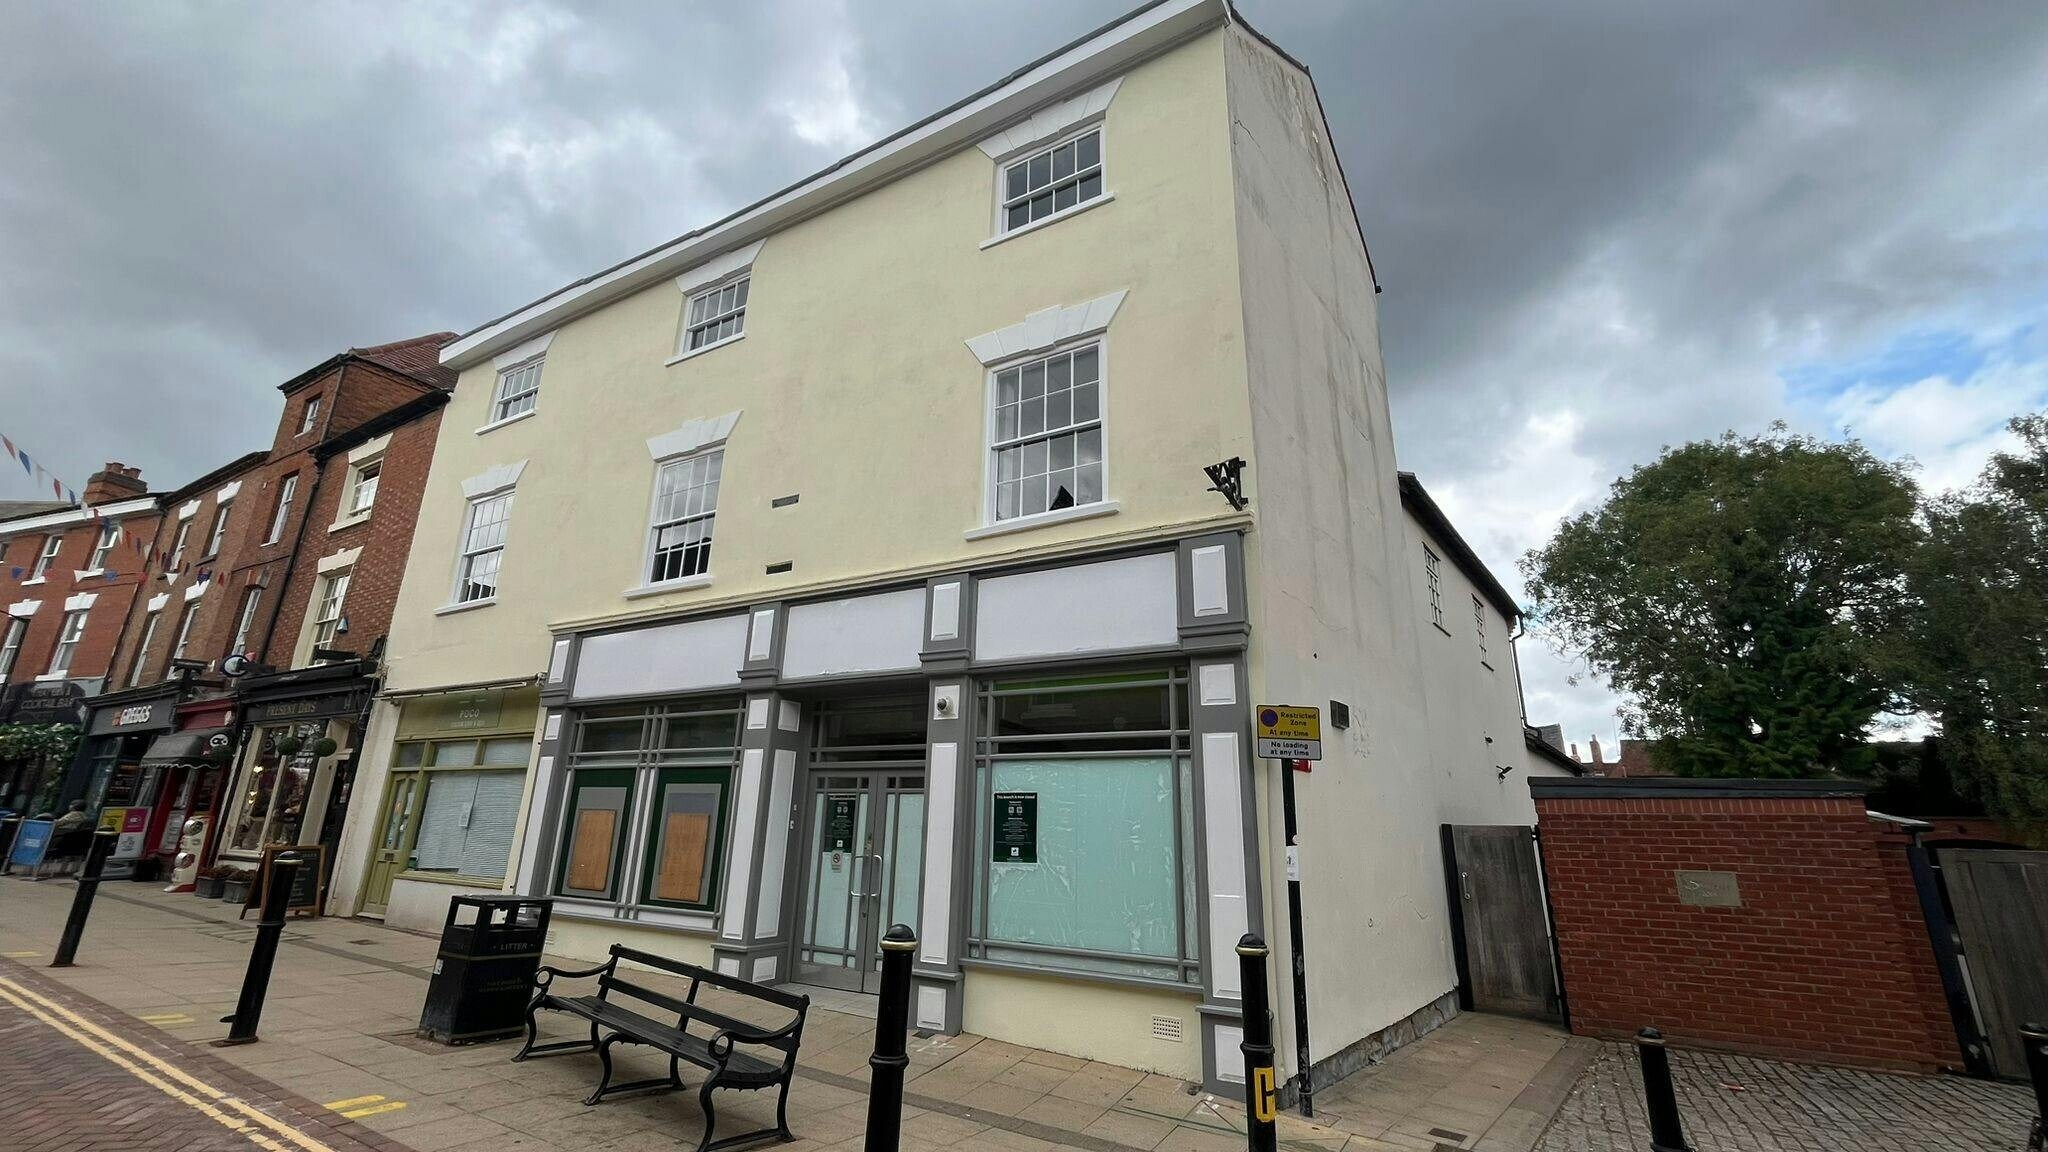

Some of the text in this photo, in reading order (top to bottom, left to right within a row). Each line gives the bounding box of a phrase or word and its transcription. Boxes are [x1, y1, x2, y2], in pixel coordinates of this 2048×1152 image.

[120, 705, 152, 725] GREGGS
[1280, 711, 1317, 719] Restricted
[1282, 741, 1309, 750] loading
[500, 941, 528, 952] LITTER
